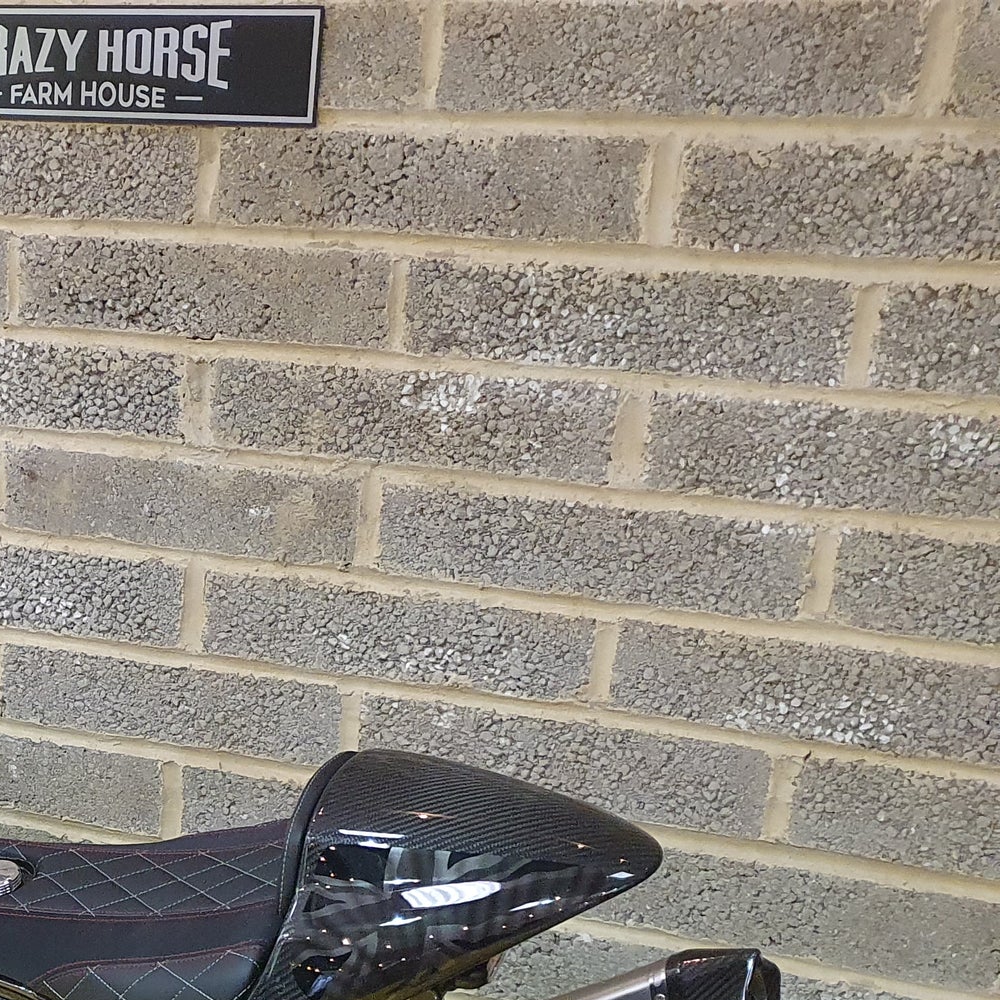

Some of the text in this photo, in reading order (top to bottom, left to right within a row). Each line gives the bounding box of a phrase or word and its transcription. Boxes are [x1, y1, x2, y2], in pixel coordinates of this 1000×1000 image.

[96, 19, 233, 90] HORSE
[9, 81, 166, 108] FARM HOUSE
